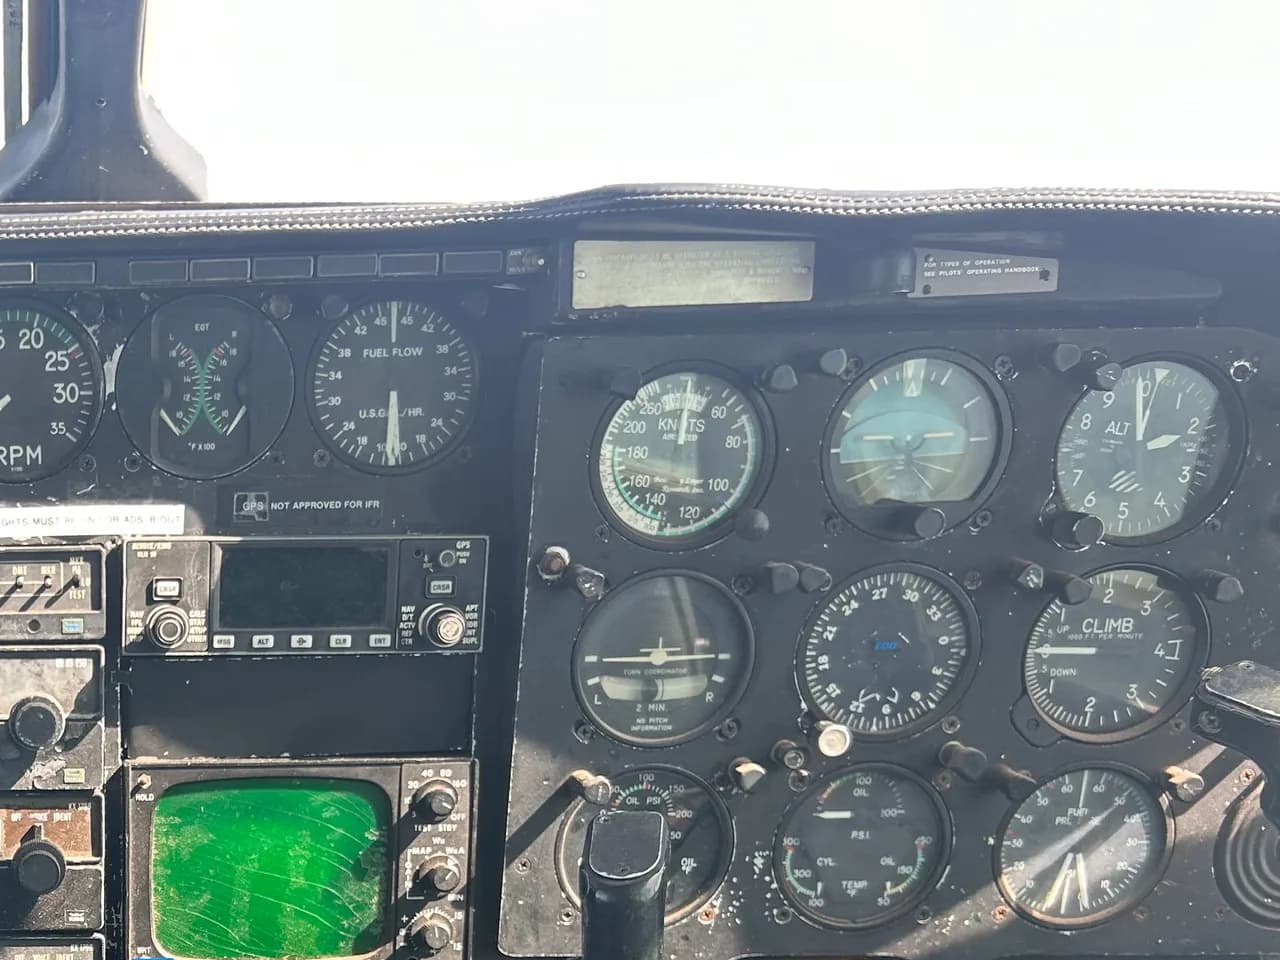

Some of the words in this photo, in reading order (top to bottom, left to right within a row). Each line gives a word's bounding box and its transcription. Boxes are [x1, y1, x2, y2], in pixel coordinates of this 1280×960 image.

[354, 326, 367, 335] 42
[19, 328, 44, 350] 20
[363, 349, 389, 358] FUEL
[392, 347, 423, 357] FLOW
[45, 351, 70, 372] 25
[328, 372, 342, 380] 34
[53, 383, 79, 403] 30
[443, 392, 456, 401] 30
[328, 396, 341, 406] 30
[639, 403, 662, 415] 260
[711, 407, 726, 419] 60
[49, 422, 66, 434] 35
[342, 421, 356, 430] 24
[623, 421, 646, 433] 200
[1105, 422, 1131, 435] ALT
[725, 436, 741, 448] 80
[627, 447, 648, 459] 180
[629, 476, 650, 488] 160
[708, 479, 729, 491] 100
[242, 502, 264, 511] GPS
[271, 502, 290, 510] NOT
[292, 502, 342, 510] APPROVED
[344, 501, 362, 509] FOR
[365, 500, 380, 508] IFR
[645, 494, 666, 505] 140
[679, 507, 700, 519] 120
[456, 541, 471, 549] GPS
[872, 588, 888, 600] 27
[902, 589, 919, 602] 30
[842, 600, 859, 616] 24
[926, 605, 942, 621] 33
[1057, 625, 1070, 634] UP
[1082, 618, 1134, 633] CLIMB
[823, 625, 837, 641] 21
[817, 655, 829, 670] 18
[1050, 669, 1076, 677] DOWN
[825, 683, 841, 698] 15
[849, 701, 865, 713] 12
[135, 794, 154, 802] HOLD
[450, 813, 466, 821] OFF
[438, 824, 457, 832] STBY
[681, 858, 696, 867] OIL
